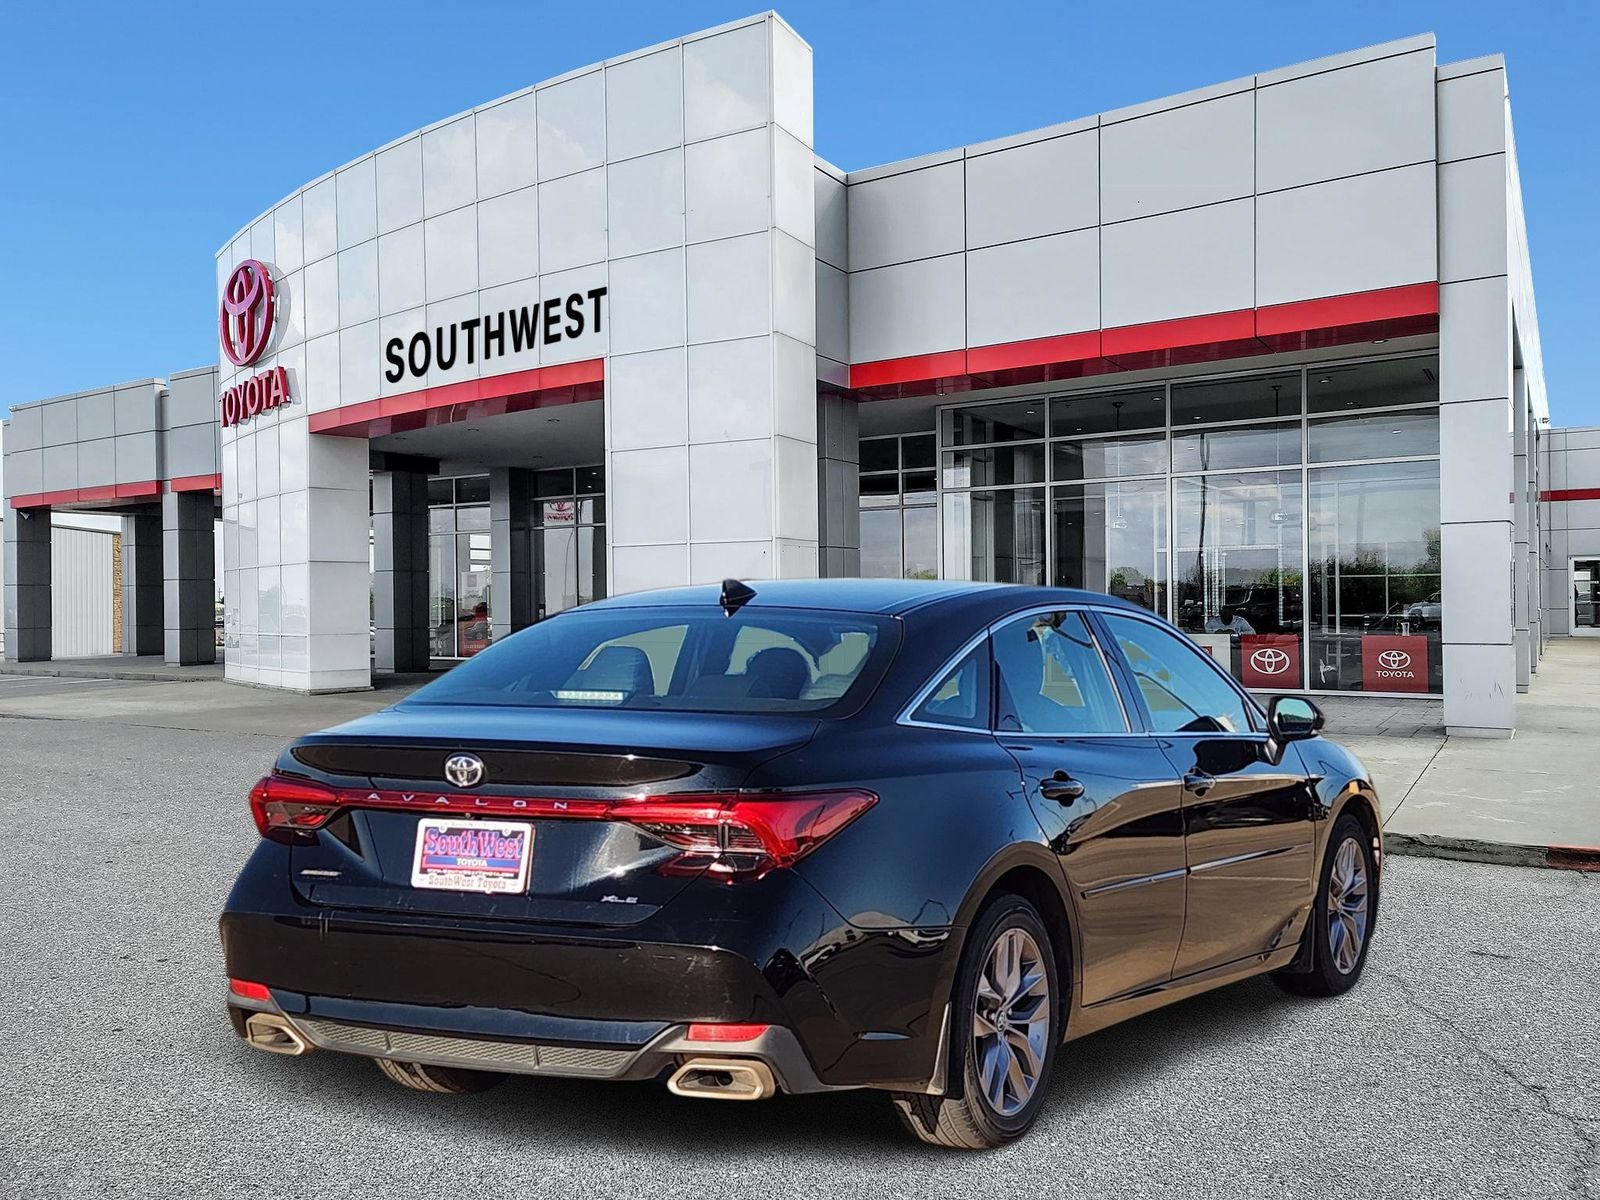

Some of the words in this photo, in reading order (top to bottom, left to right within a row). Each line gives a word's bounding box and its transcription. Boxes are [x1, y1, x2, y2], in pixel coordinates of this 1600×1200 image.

[385, 287, 608, 383] SOUTHWEST
[219, 366, 291, 429] TOYOTA
[1376, 670, 1414, 678] TOYOTA
[368, 792, 568, 809] AVALON
[424, 828, 524, 858] SouthWest
[456, 857, 488, 867] TOYOTA
